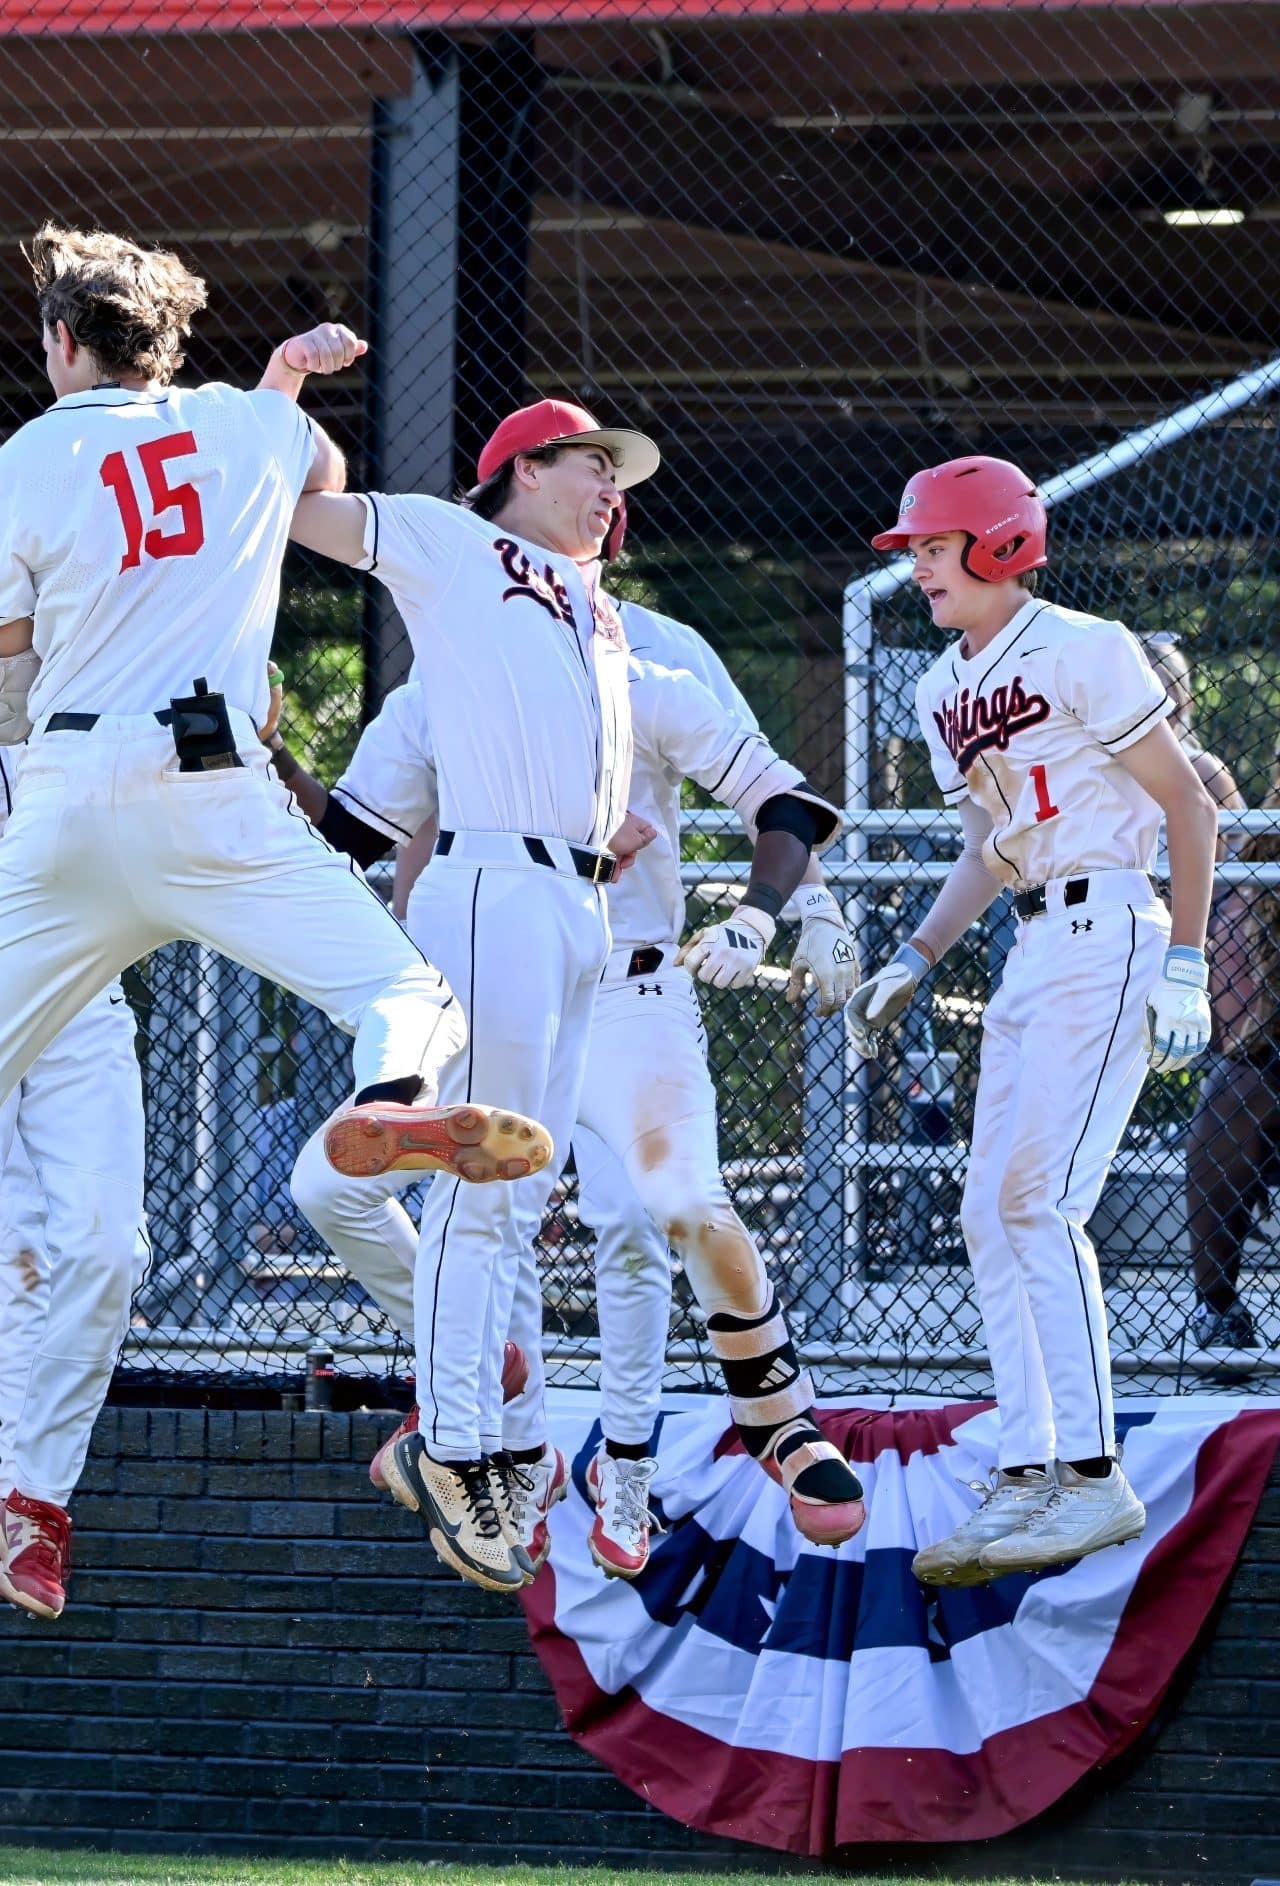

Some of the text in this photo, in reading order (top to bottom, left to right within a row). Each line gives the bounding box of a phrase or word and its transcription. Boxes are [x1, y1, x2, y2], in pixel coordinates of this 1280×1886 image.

[100, 431, 205, 575] 15
[899, 494, 916, 516] P
[1029, 764, 1060, 823] 1
